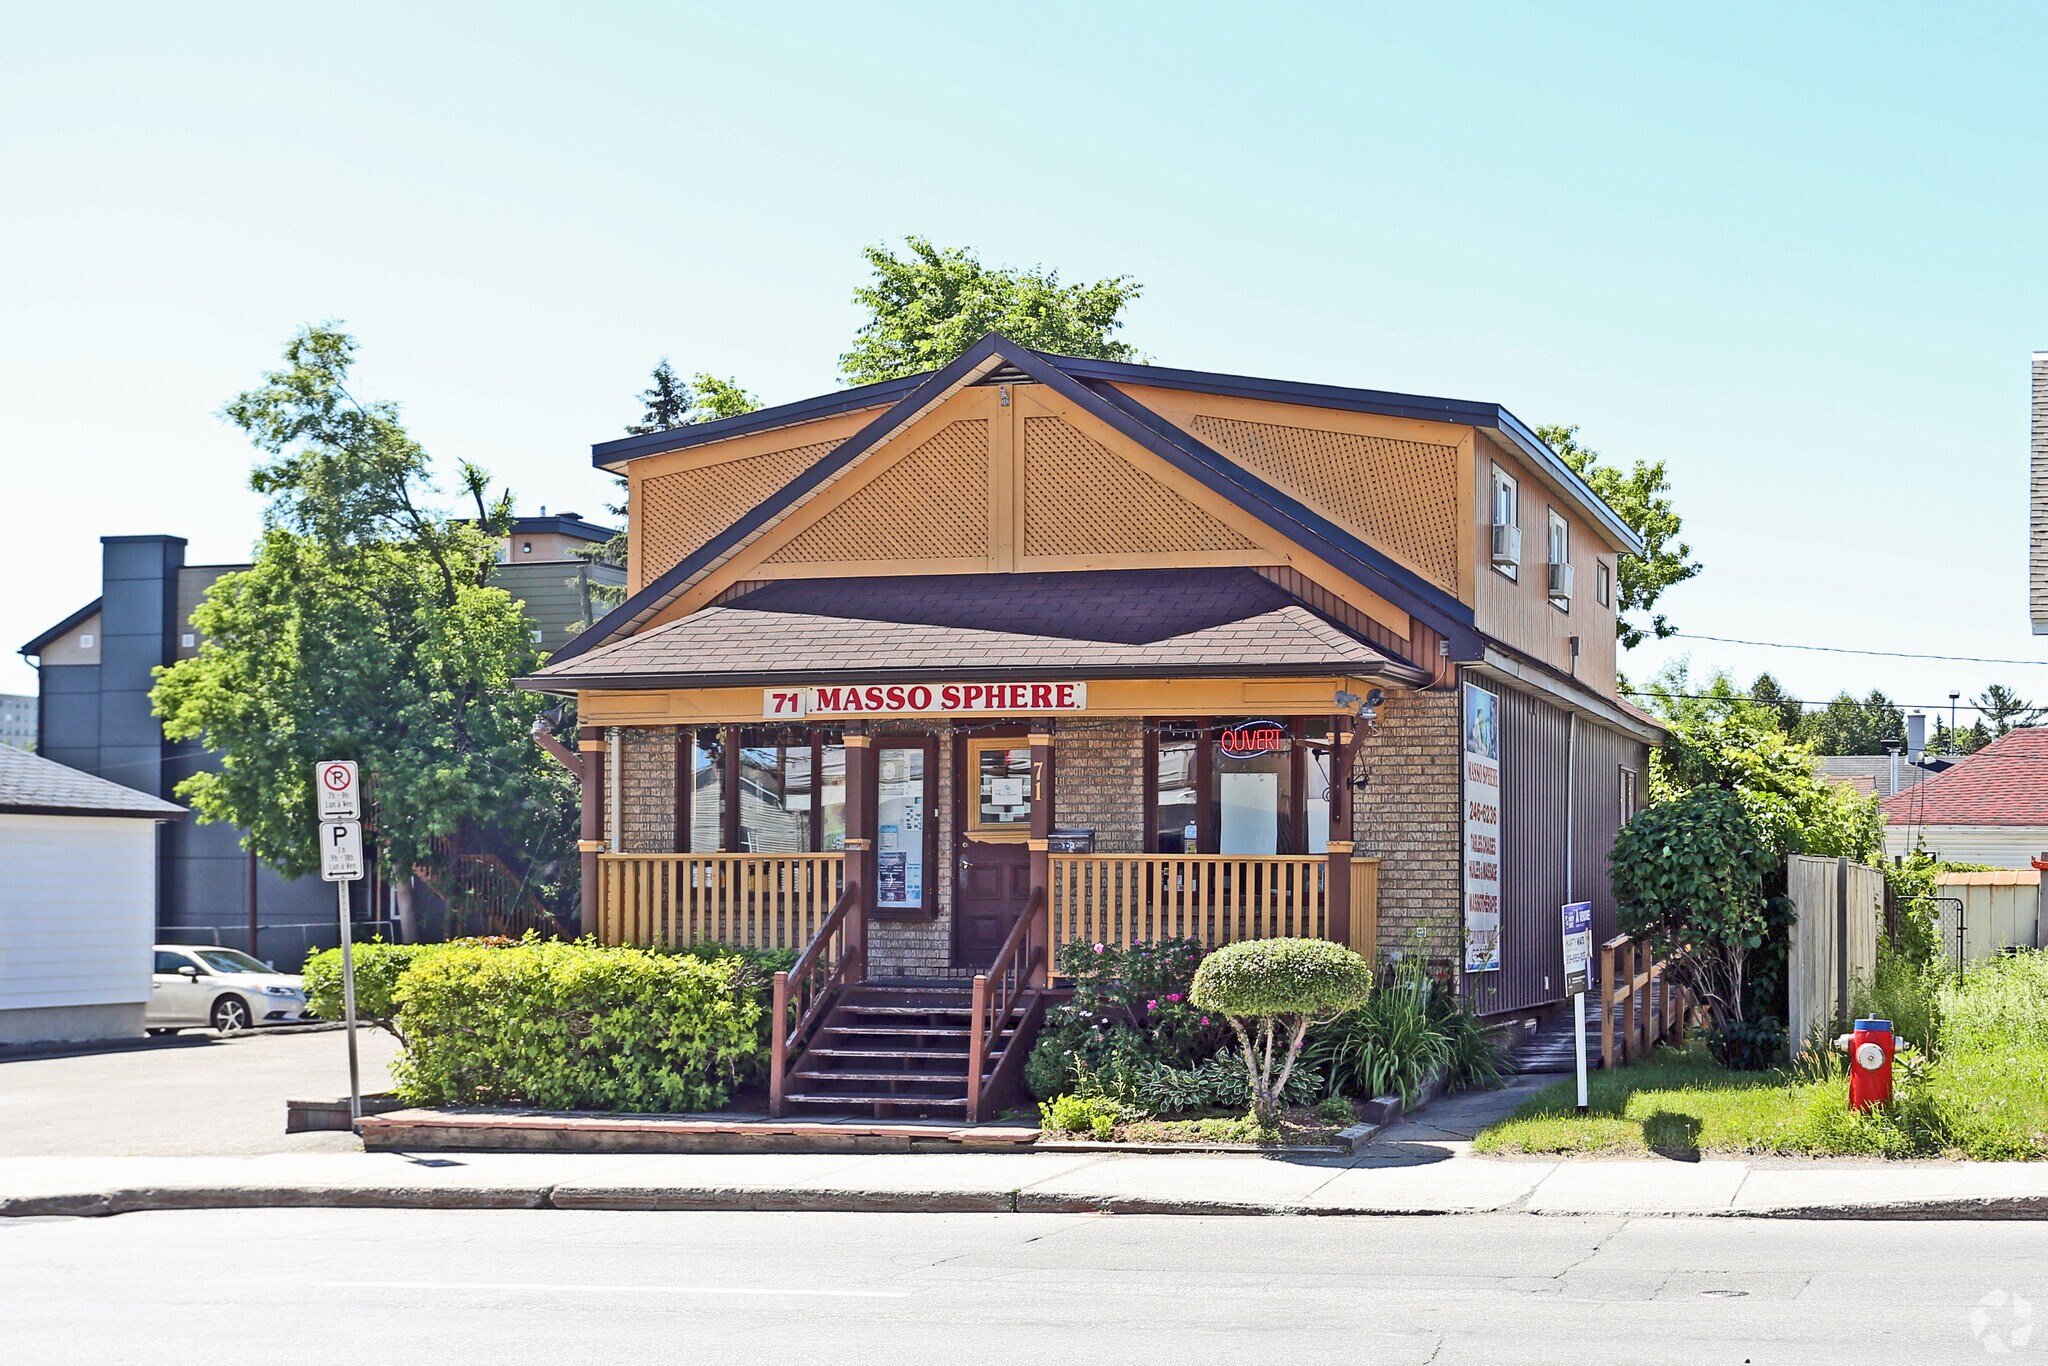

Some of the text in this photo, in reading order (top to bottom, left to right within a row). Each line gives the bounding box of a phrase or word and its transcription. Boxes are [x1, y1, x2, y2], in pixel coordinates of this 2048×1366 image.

[772, 693, 799, 714] 71
[816, 684, 1076, 711] MASSO SPHERE
[1221, 729, 1282, 752] OUVERT
[1033, 761, 1044, 801] 71
[333, 826, 348, 847] P
